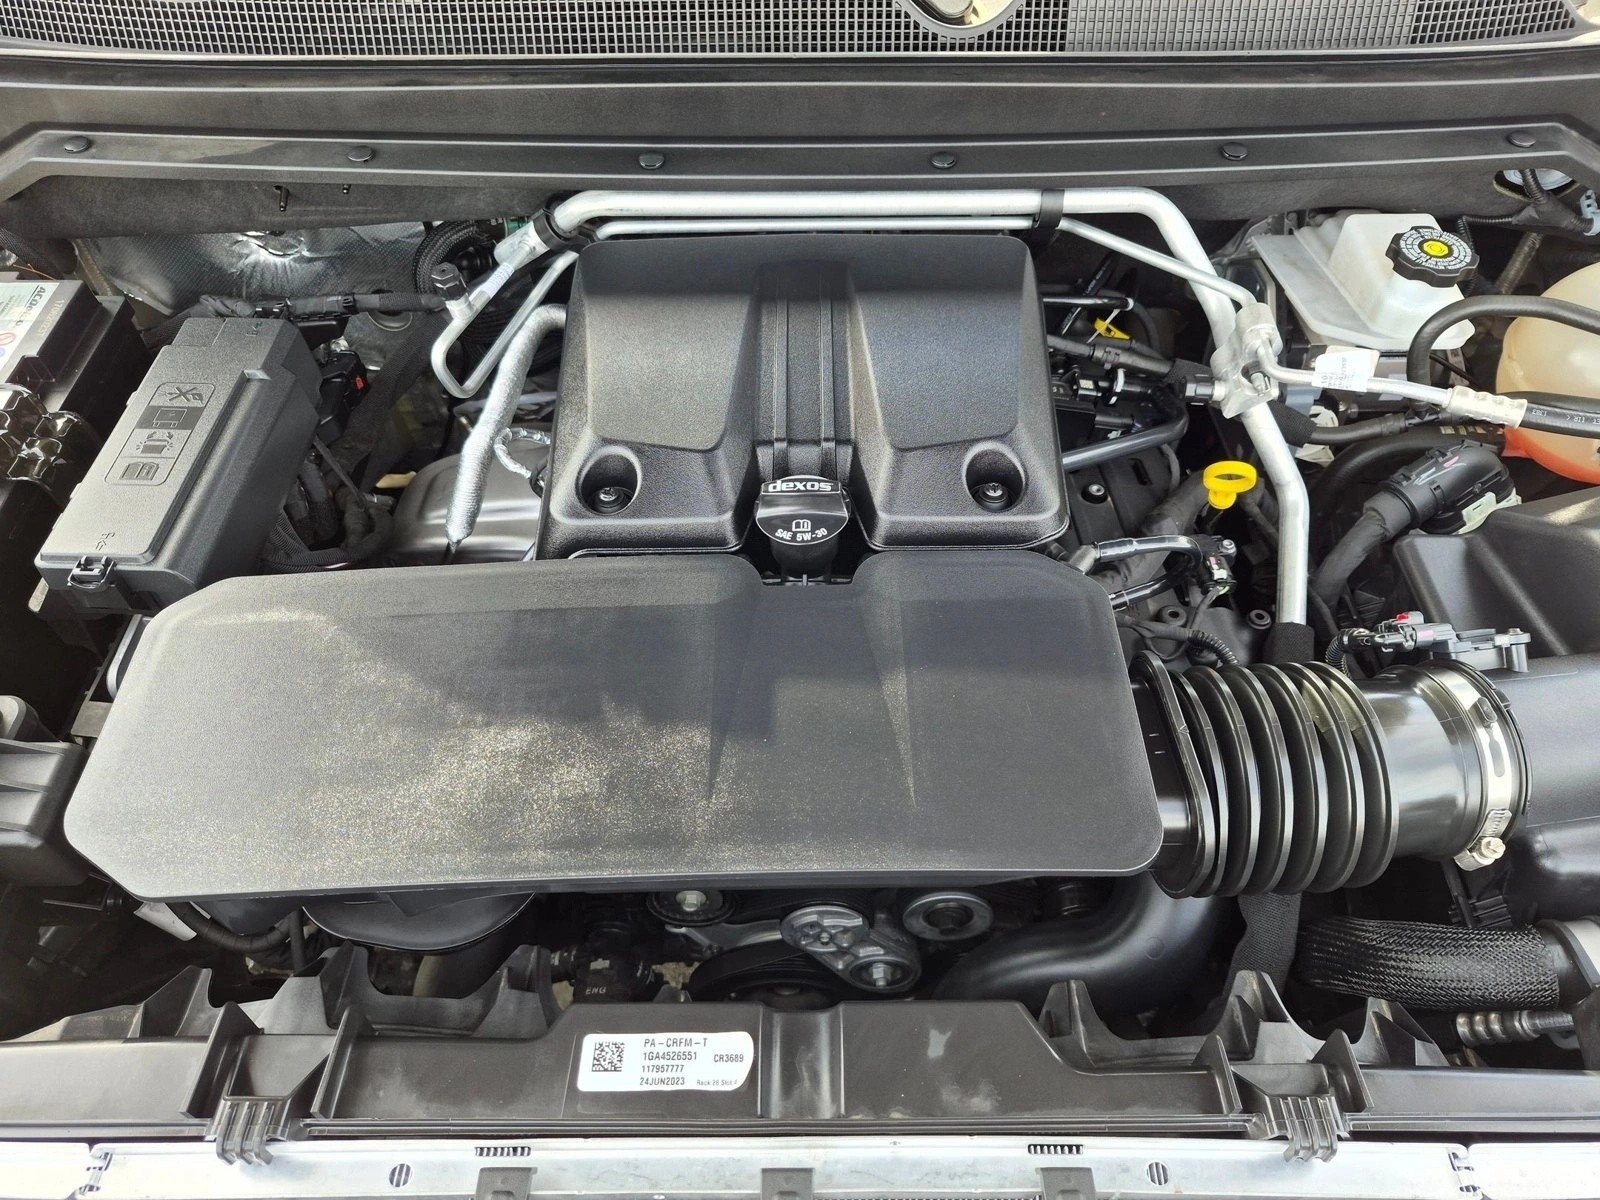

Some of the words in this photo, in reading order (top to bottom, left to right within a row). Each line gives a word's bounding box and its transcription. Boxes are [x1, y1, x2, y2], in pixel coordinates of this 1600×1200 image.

[768, 480, 832, 492] dexos
[775, 528, 793, 540] SAE
[796, 527, 828, 541] 5W-30
[643, 1050, 698, 1061] 1GA4526551
[713, 1053, 745, 1063] CR3689
[641, 1064, 685, 1073] 117957777
[639, 1076, 686, 1086] 24JUN2023
